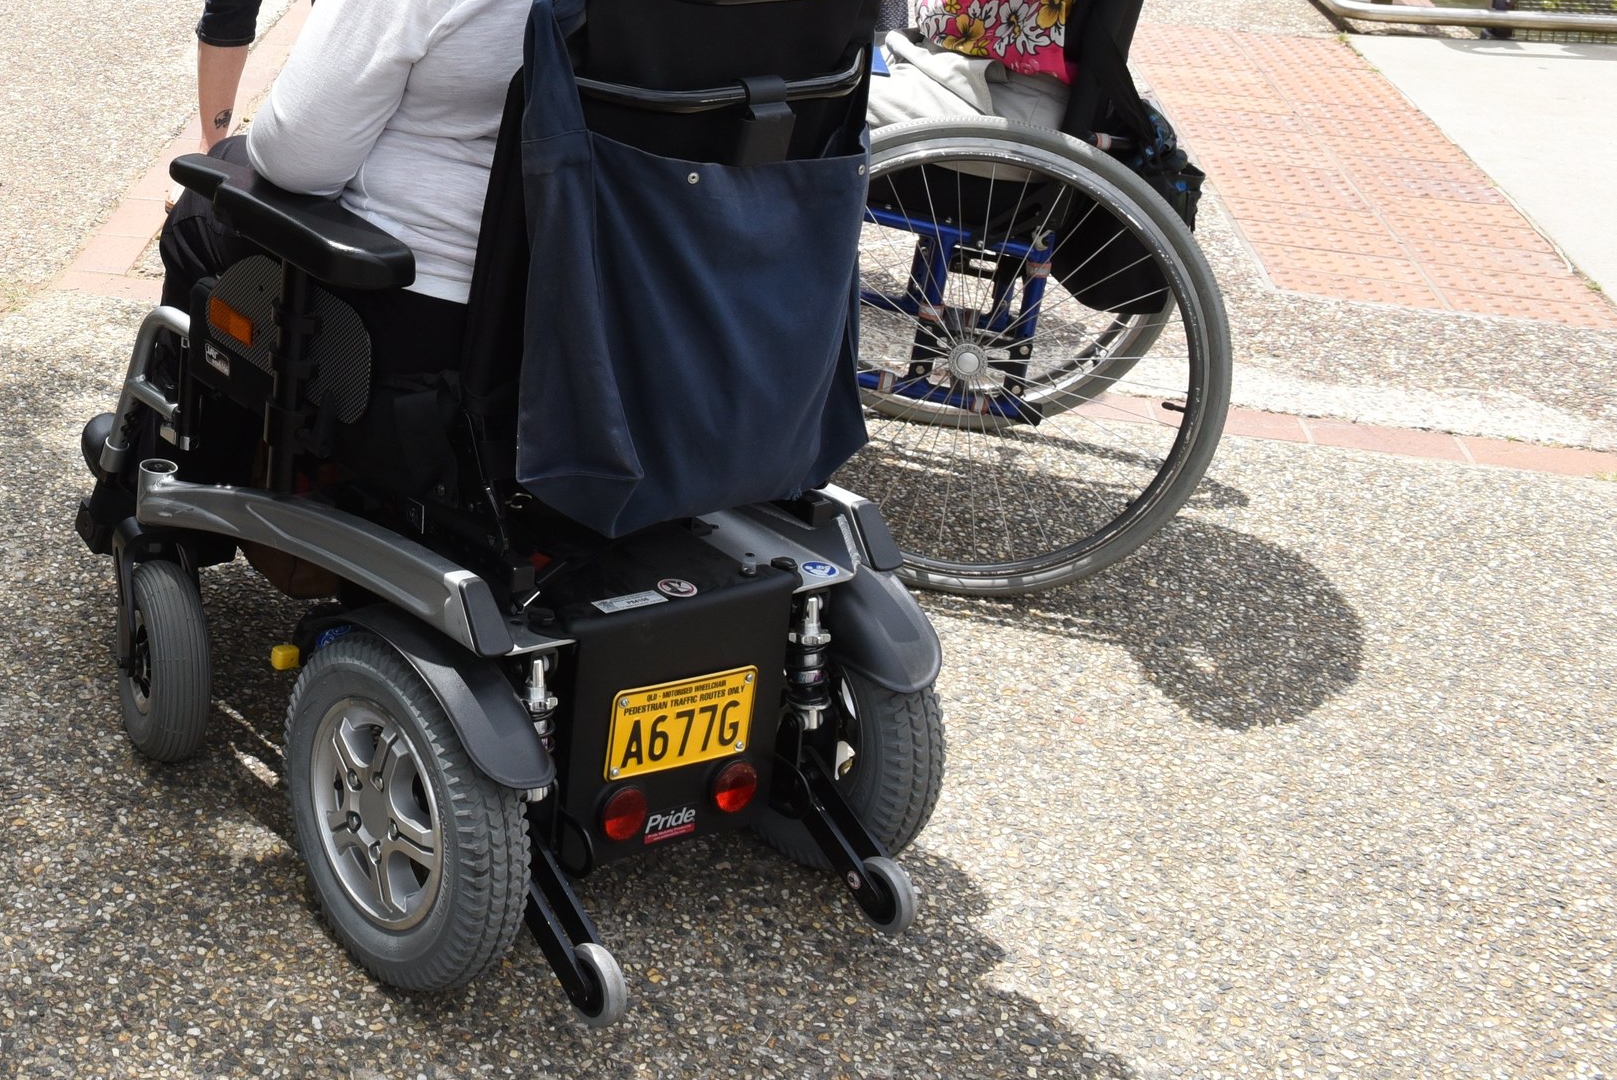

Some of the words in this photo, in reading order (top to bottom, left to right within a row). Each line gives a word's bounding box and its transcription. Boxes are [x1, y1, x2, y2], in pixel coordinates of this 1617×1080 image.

[623, 700, 668, 717] PEDESTRIAN
[670, 695, 698, 707] TRAFFIC
[699, 689, 726, 702] ROUTES
[727, 684, 745, 696] ONLY
[646, 693, 658, 702] QLD
[662, 686, 693, 699] MOTORISED
[694, 680, 727, 692] WHEELCHAIR
[620, 699, 740, 769] A677G
[644, 806, 696, 834] Pride
